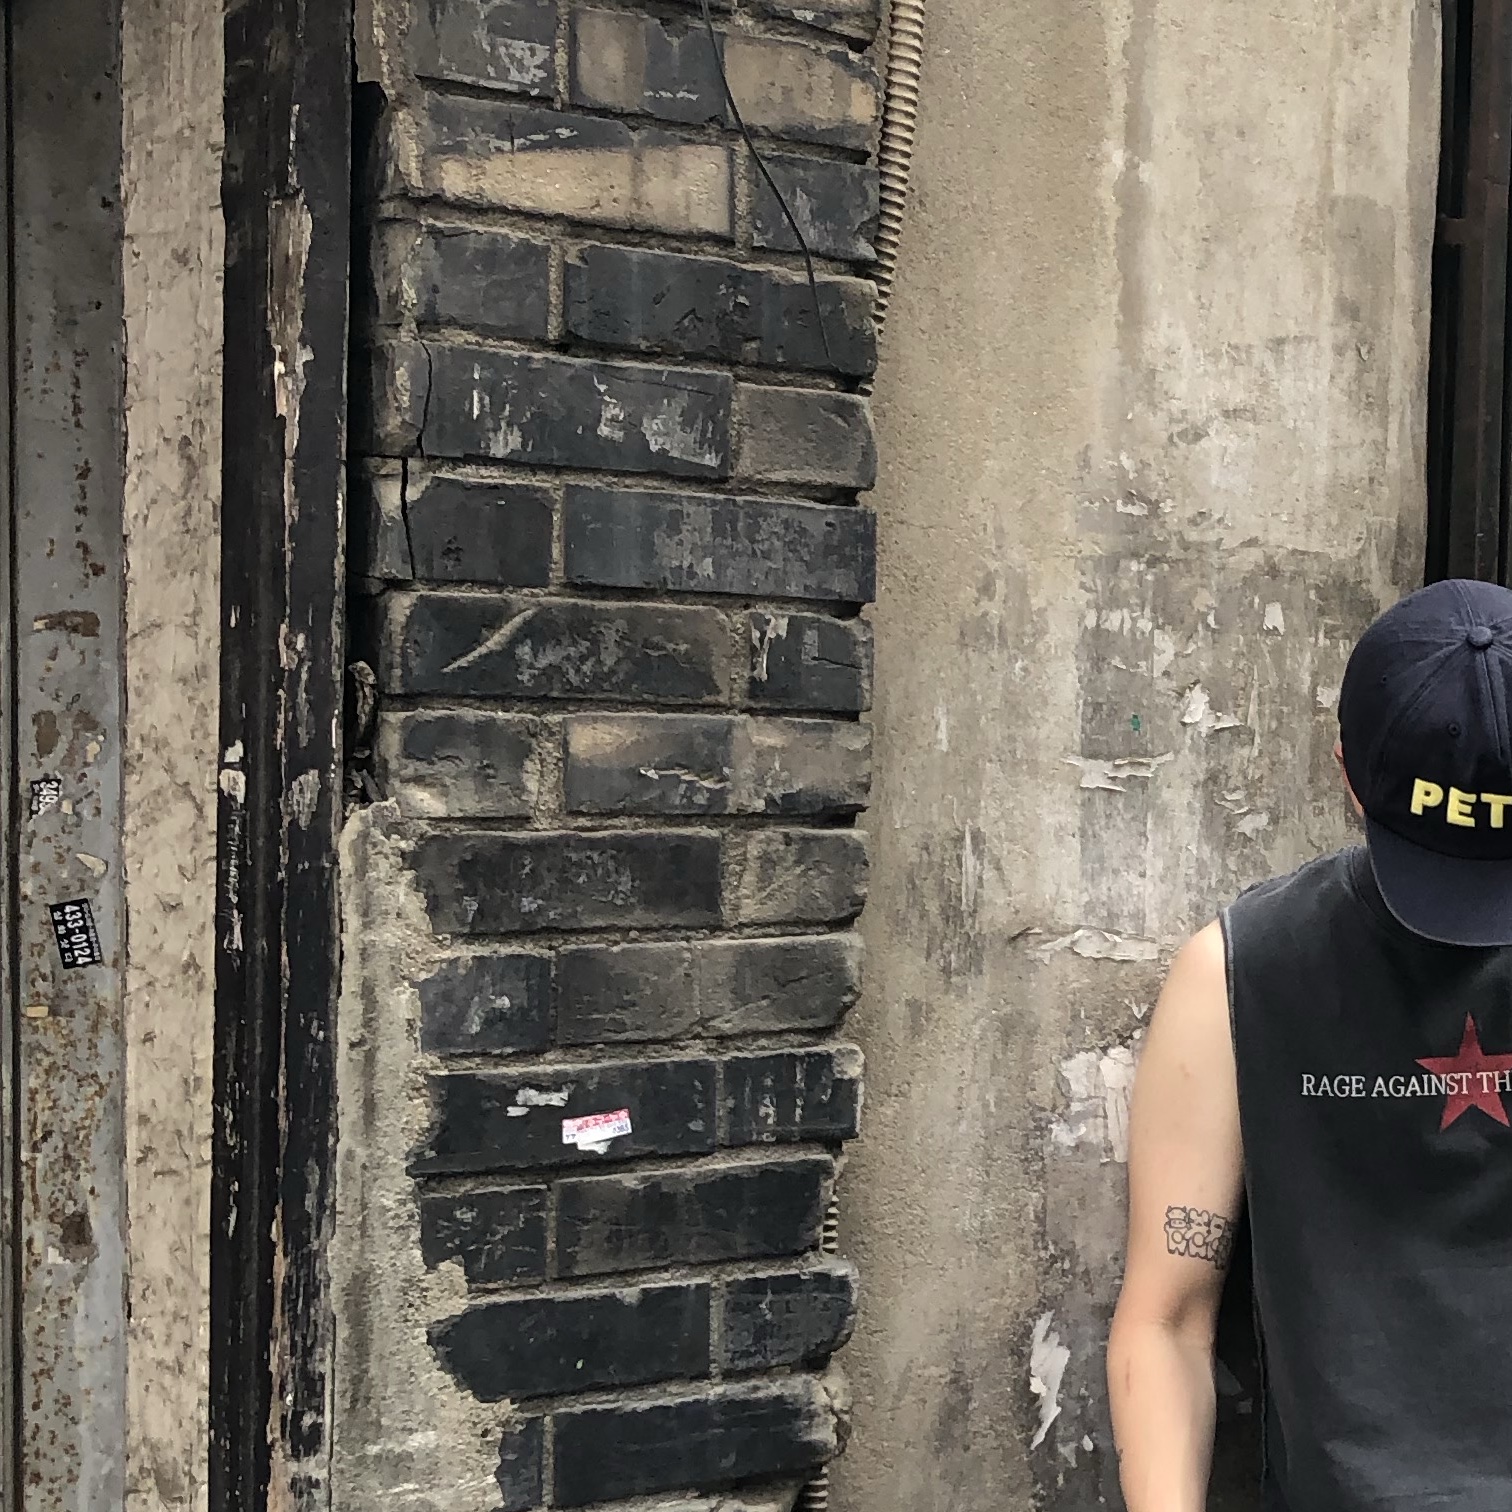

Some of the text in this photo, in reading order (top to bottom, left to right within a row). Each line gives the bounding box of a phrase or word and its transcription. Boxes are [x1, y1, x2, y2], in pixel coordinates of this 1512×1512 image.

[63, 903, 94, 966] 433-0124
[1300, 1073, 1367, 1098] RAGE
[1370, 1072, 1472, 1098] AGAINST
